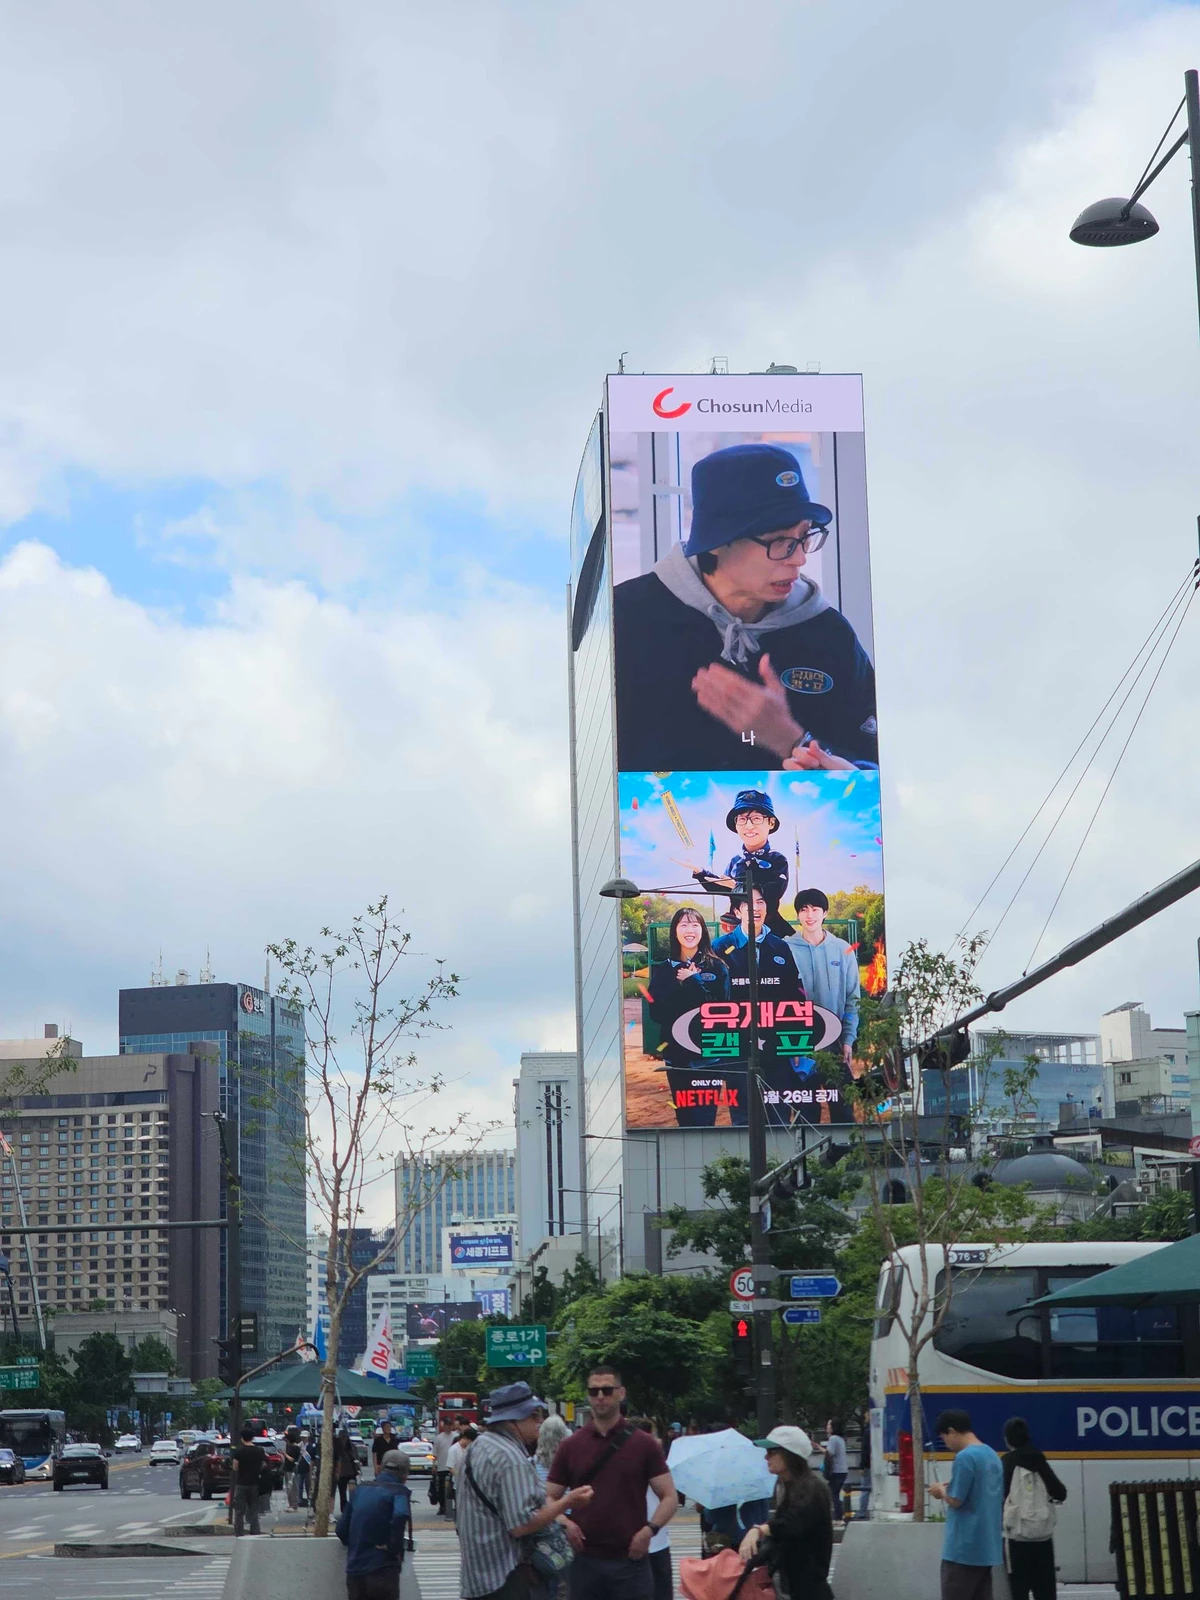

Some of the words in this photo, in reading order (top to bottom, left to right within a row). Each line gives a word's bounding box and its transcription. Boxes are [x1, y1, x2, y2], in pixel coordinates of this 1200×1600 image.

[697, 399, 813, 413] ChosunMedia
[741, 730, 756, 746] 나
[760, 977, 781, 985] 시리즈
[700, 1000, 814, 1029] 유재석
[691, 1079, 711, 1087] ONLY
[675, 1089, 739, 1108] NETFLIX
[783, 1089, 813, 1104] 26일
[815, 1089, 839, 1103] 공개
[737, 1276, 755, 1292] 50
[491, 1329, 540, 1343] 종로1가
[1076, 1405, 1200, 1437] POLICE
